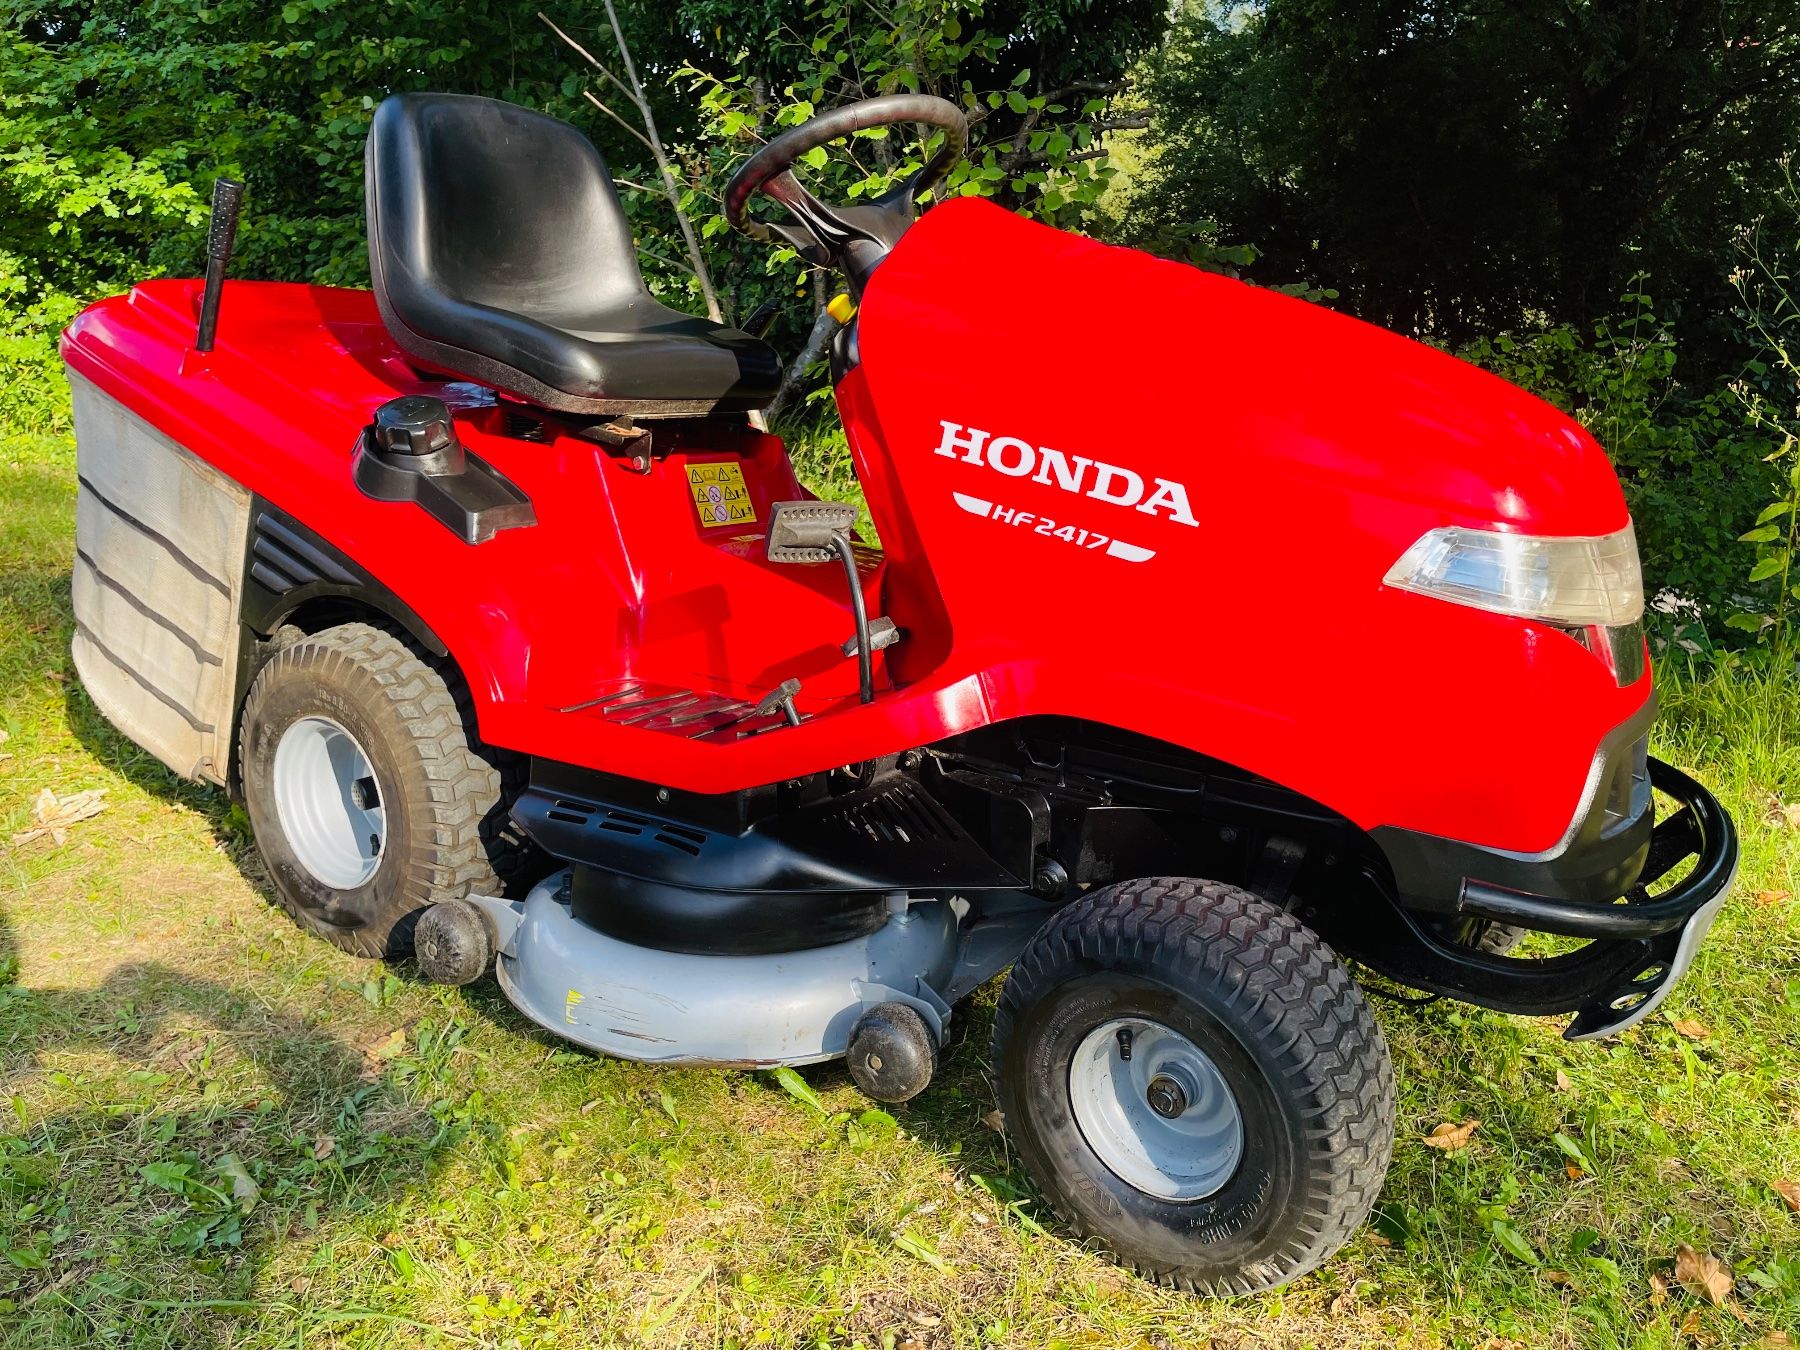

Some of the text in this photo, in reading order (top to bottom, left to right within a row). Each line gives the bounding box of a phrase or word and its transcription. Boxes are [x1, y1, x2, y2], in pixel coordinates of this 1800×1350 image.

[934, 420, 1200, 527] HONDA
[991, 504, 1110, 549] HF 2417
